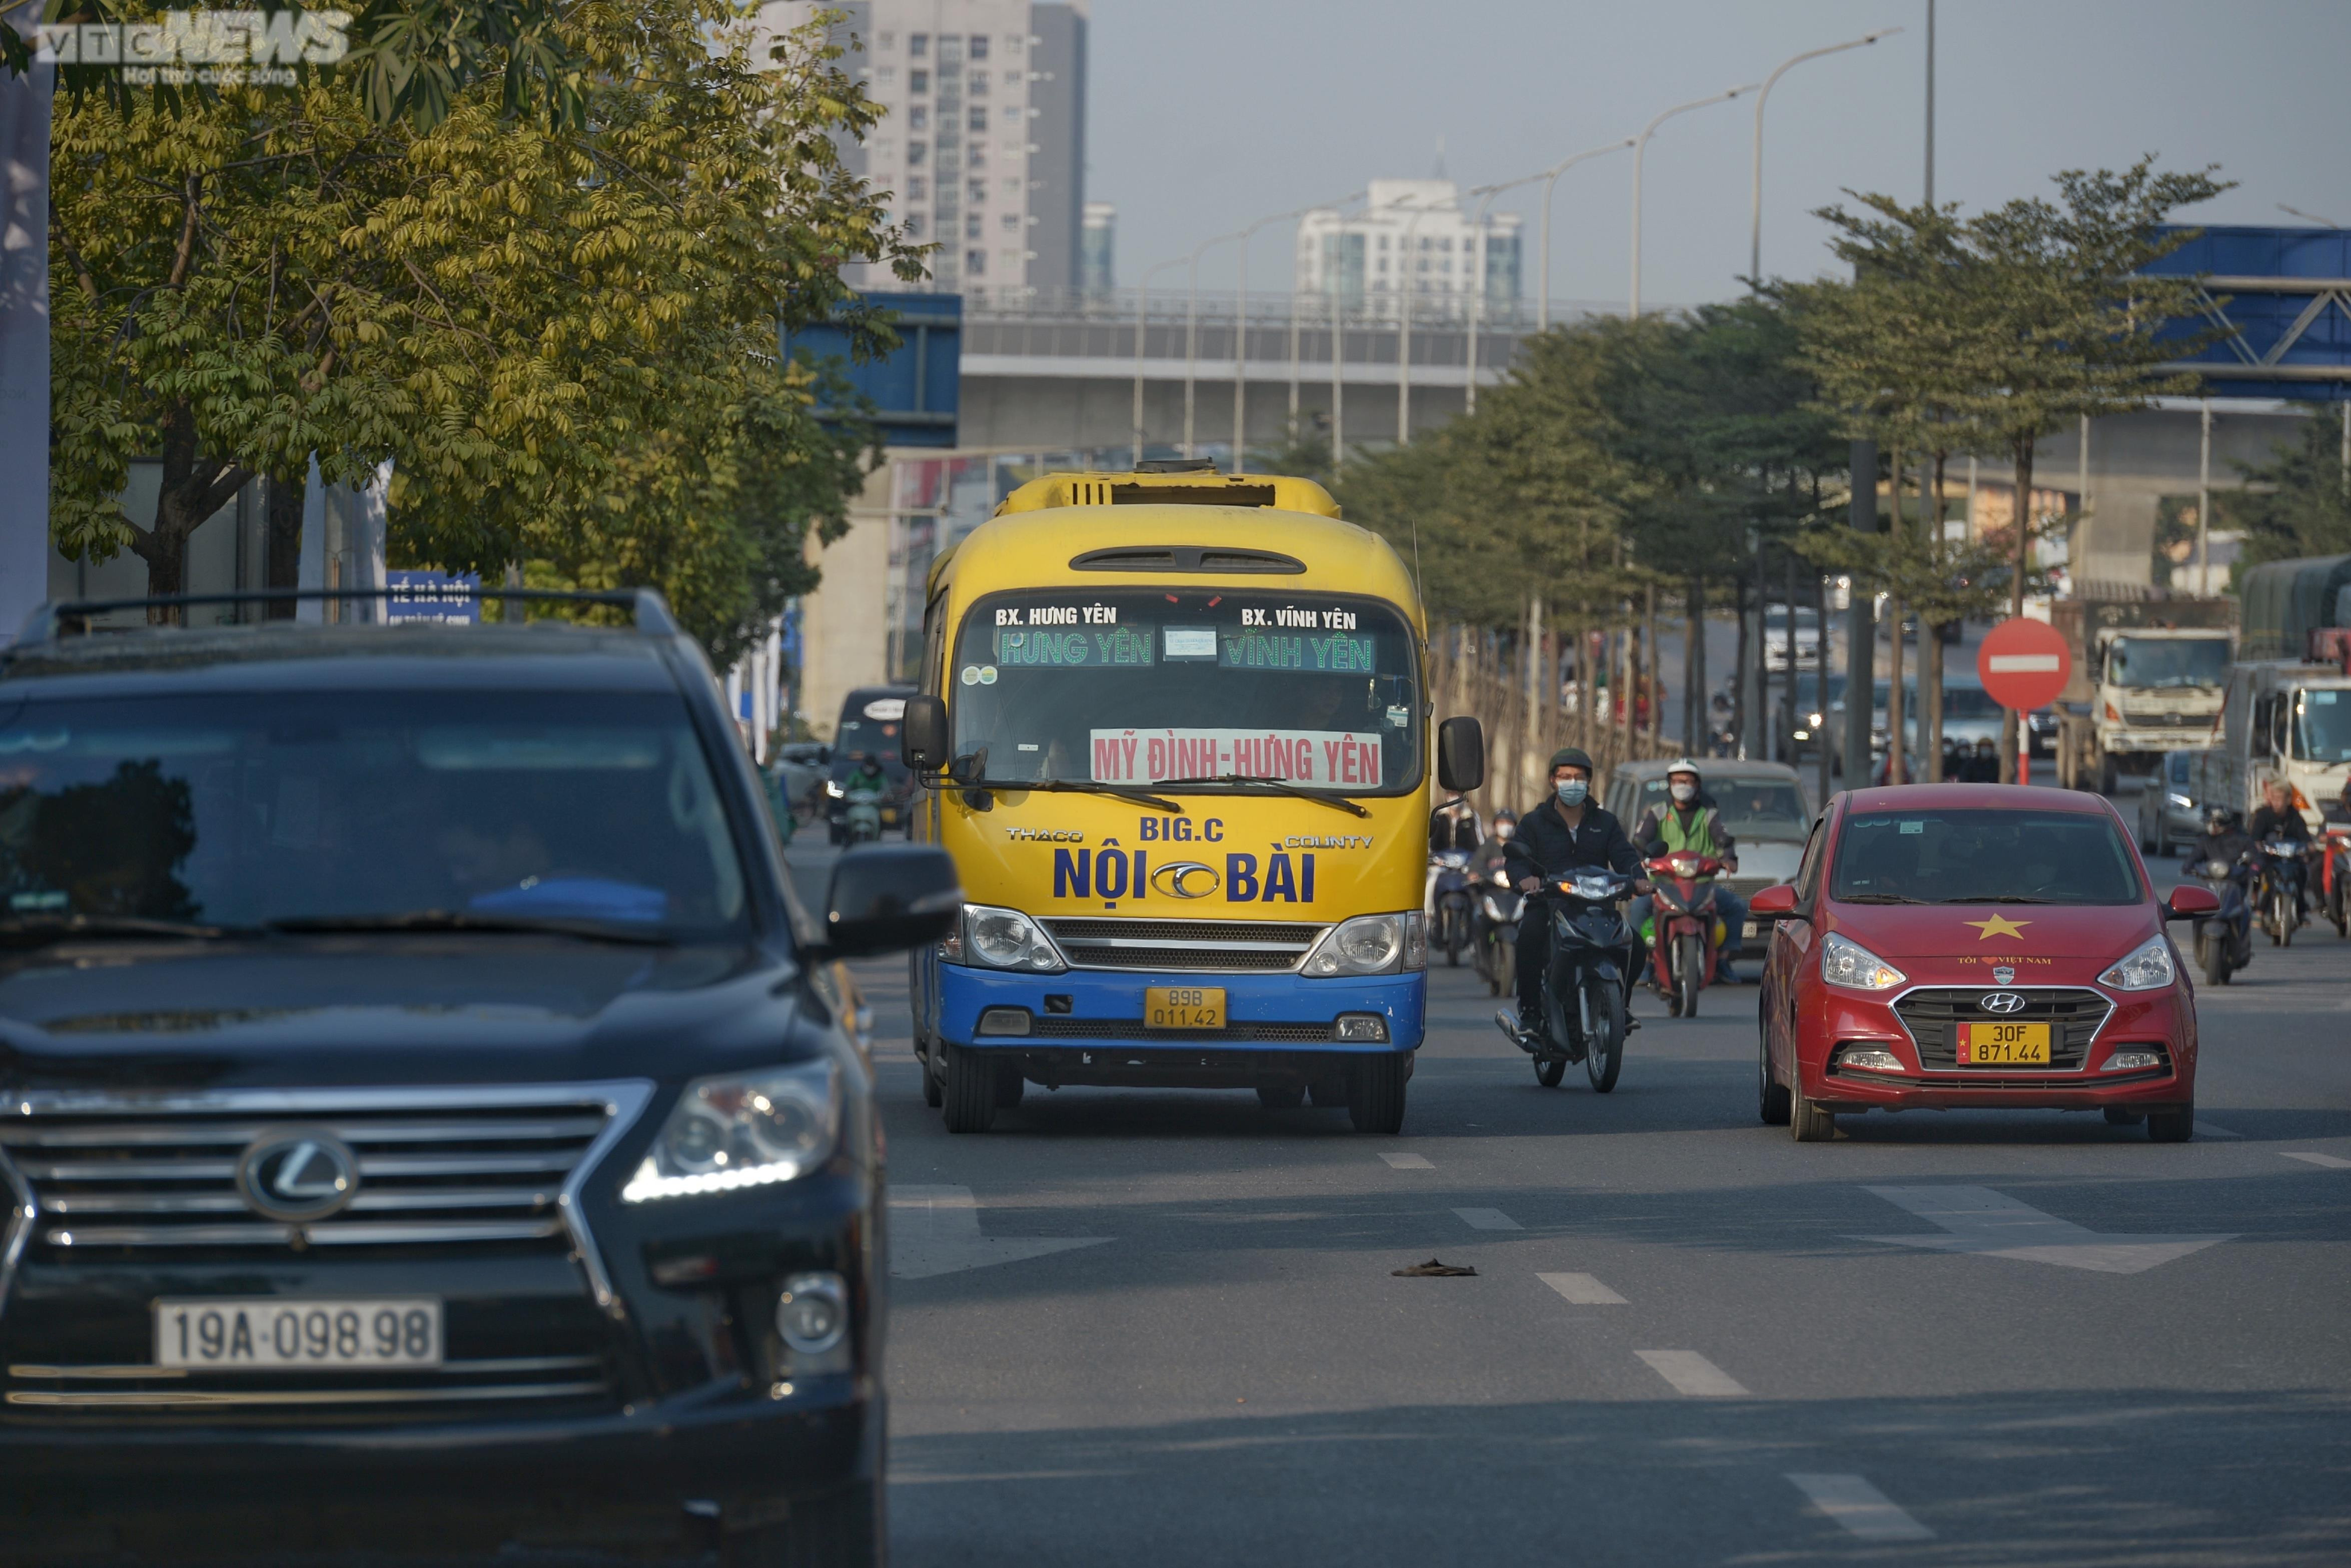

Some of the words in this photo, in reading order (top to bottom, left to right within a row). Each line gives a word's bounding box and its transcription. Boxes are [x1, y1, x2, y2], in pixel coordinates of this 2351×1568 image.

[996, 608, 1024, 625] BX.
[1029, 606, 1078, 625] HƯNG
[1083, 602, 1117, 624] YÊN
[1241, 608, 1272, 625] BX.
[1276, 605, 1317, 627] VĨNH
[1322, 607, 1356, 630] YÊN
[1002, 631, 1088, 664] HƯNG
[1095, 626, 1151, 663] YÊN
[1223, 628, 1301, 667] VĨNH
[1310, 631, 1371, 670] YÊN
[1094, 730, 1138, 780] MỸ
[1323, 733, 1378, 785] YÊN
[1006, 827, 1084, 843] THACO
[1140, 817, 1224, 842] BIG.C
[1284, 836, 1374, 849] COUNTY
[1053, 838, 1147, 910] NỘI
[1226, 843, 1315, 903] BÀI
[1957, 956, 1977, 964] TÔI
[1998, 956, 2023, 965] VIỆT
[2026, 957, 2051, 965] NAM
[1169, 990, 1202, 1007] 89B
[1154, 1009, 1216, 1026] 011.42
[1993, 1026, 2027, 1042] 30F
[1979, 1044, 2040, 1061] 871.44
